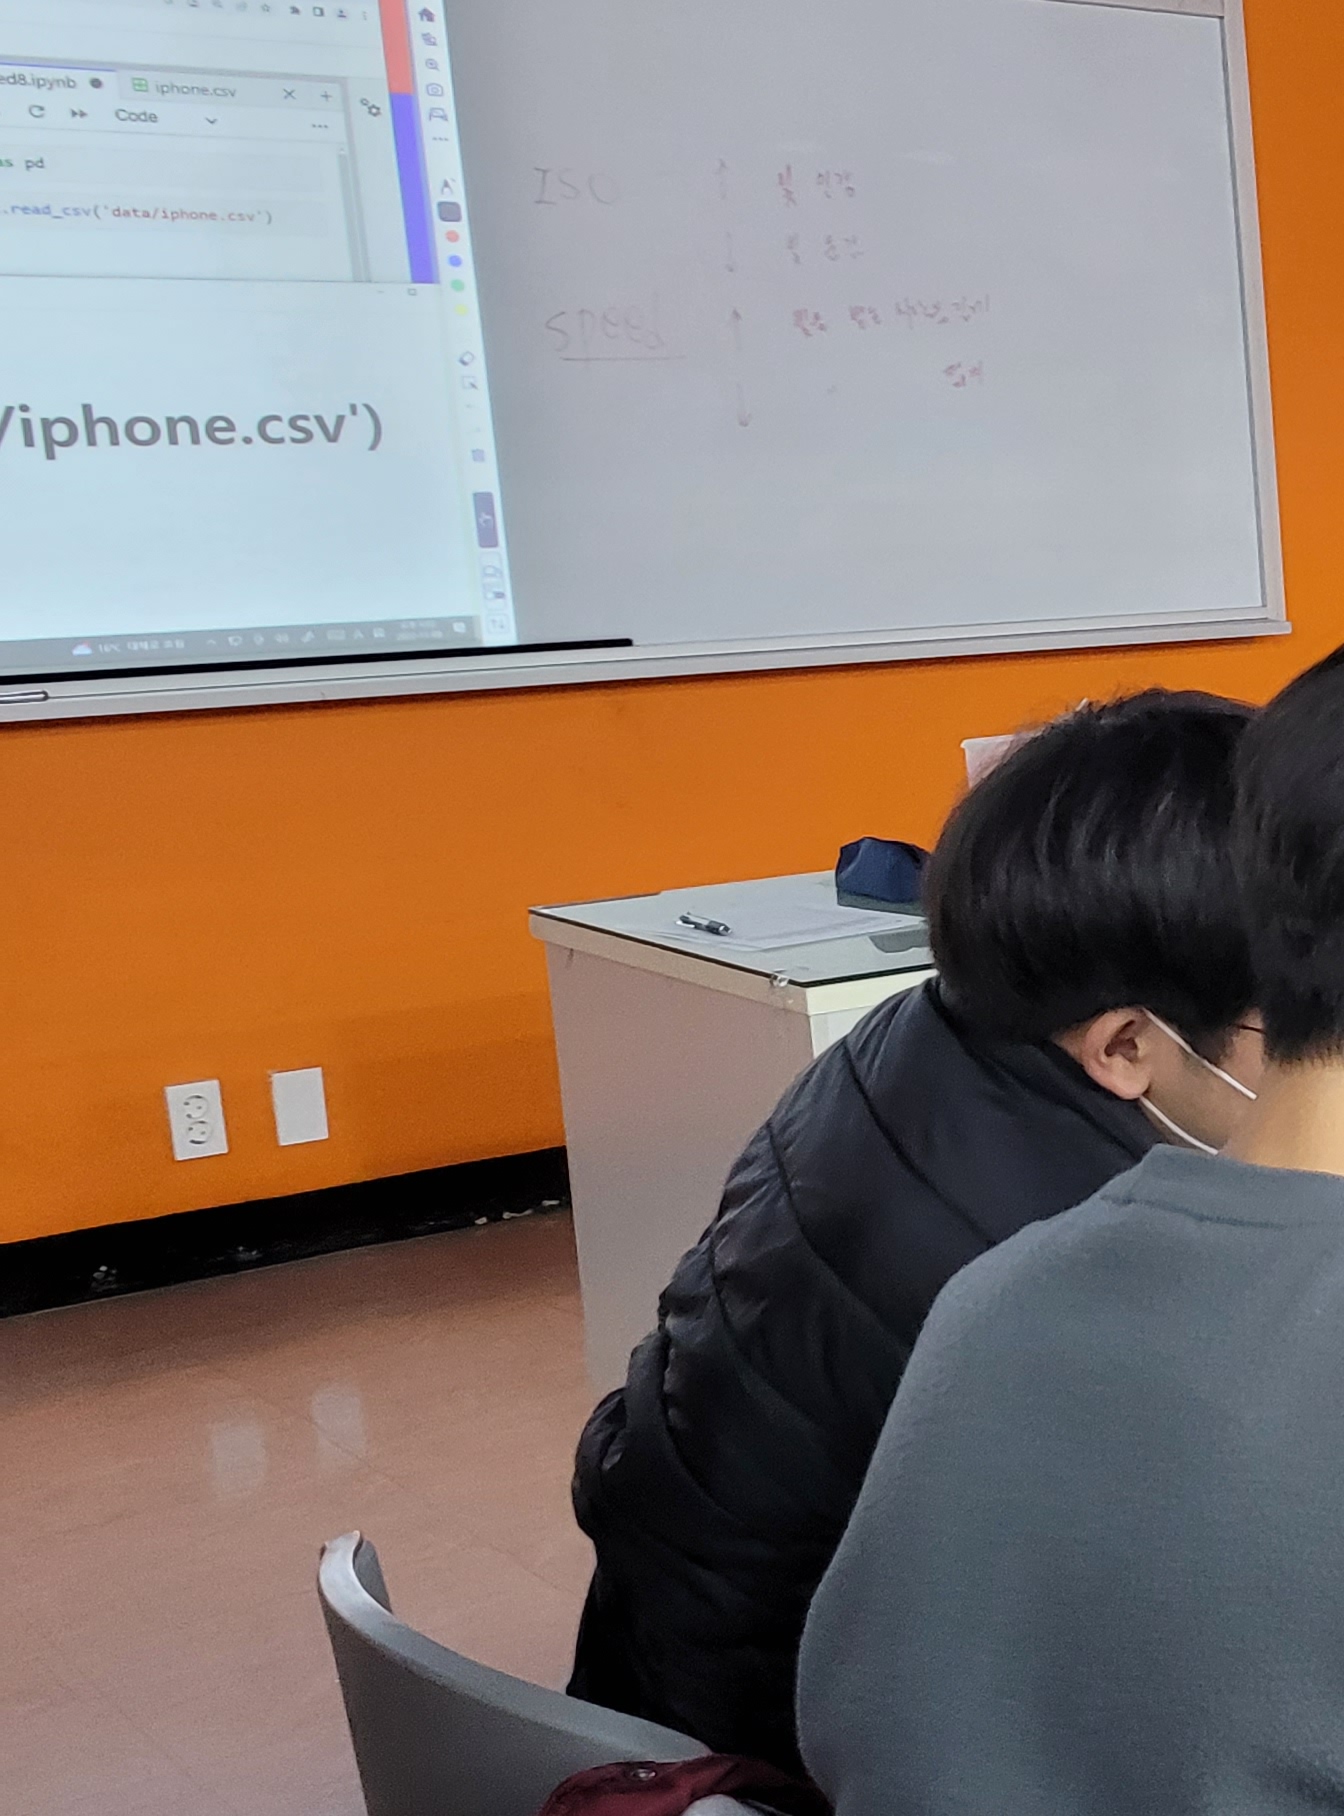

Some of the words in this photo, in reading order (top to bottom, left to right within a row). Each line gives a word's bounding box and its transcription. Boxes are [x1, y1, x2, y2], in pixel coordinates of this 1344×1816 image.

[155, 82, 237, 98] iphone.csv
[115, 109, 158, 123] Code
[24, 156, 45, 171] pd
[532, 166, 620, 205] ISO
[0, 402, 383, 460] /iphone.csv')
